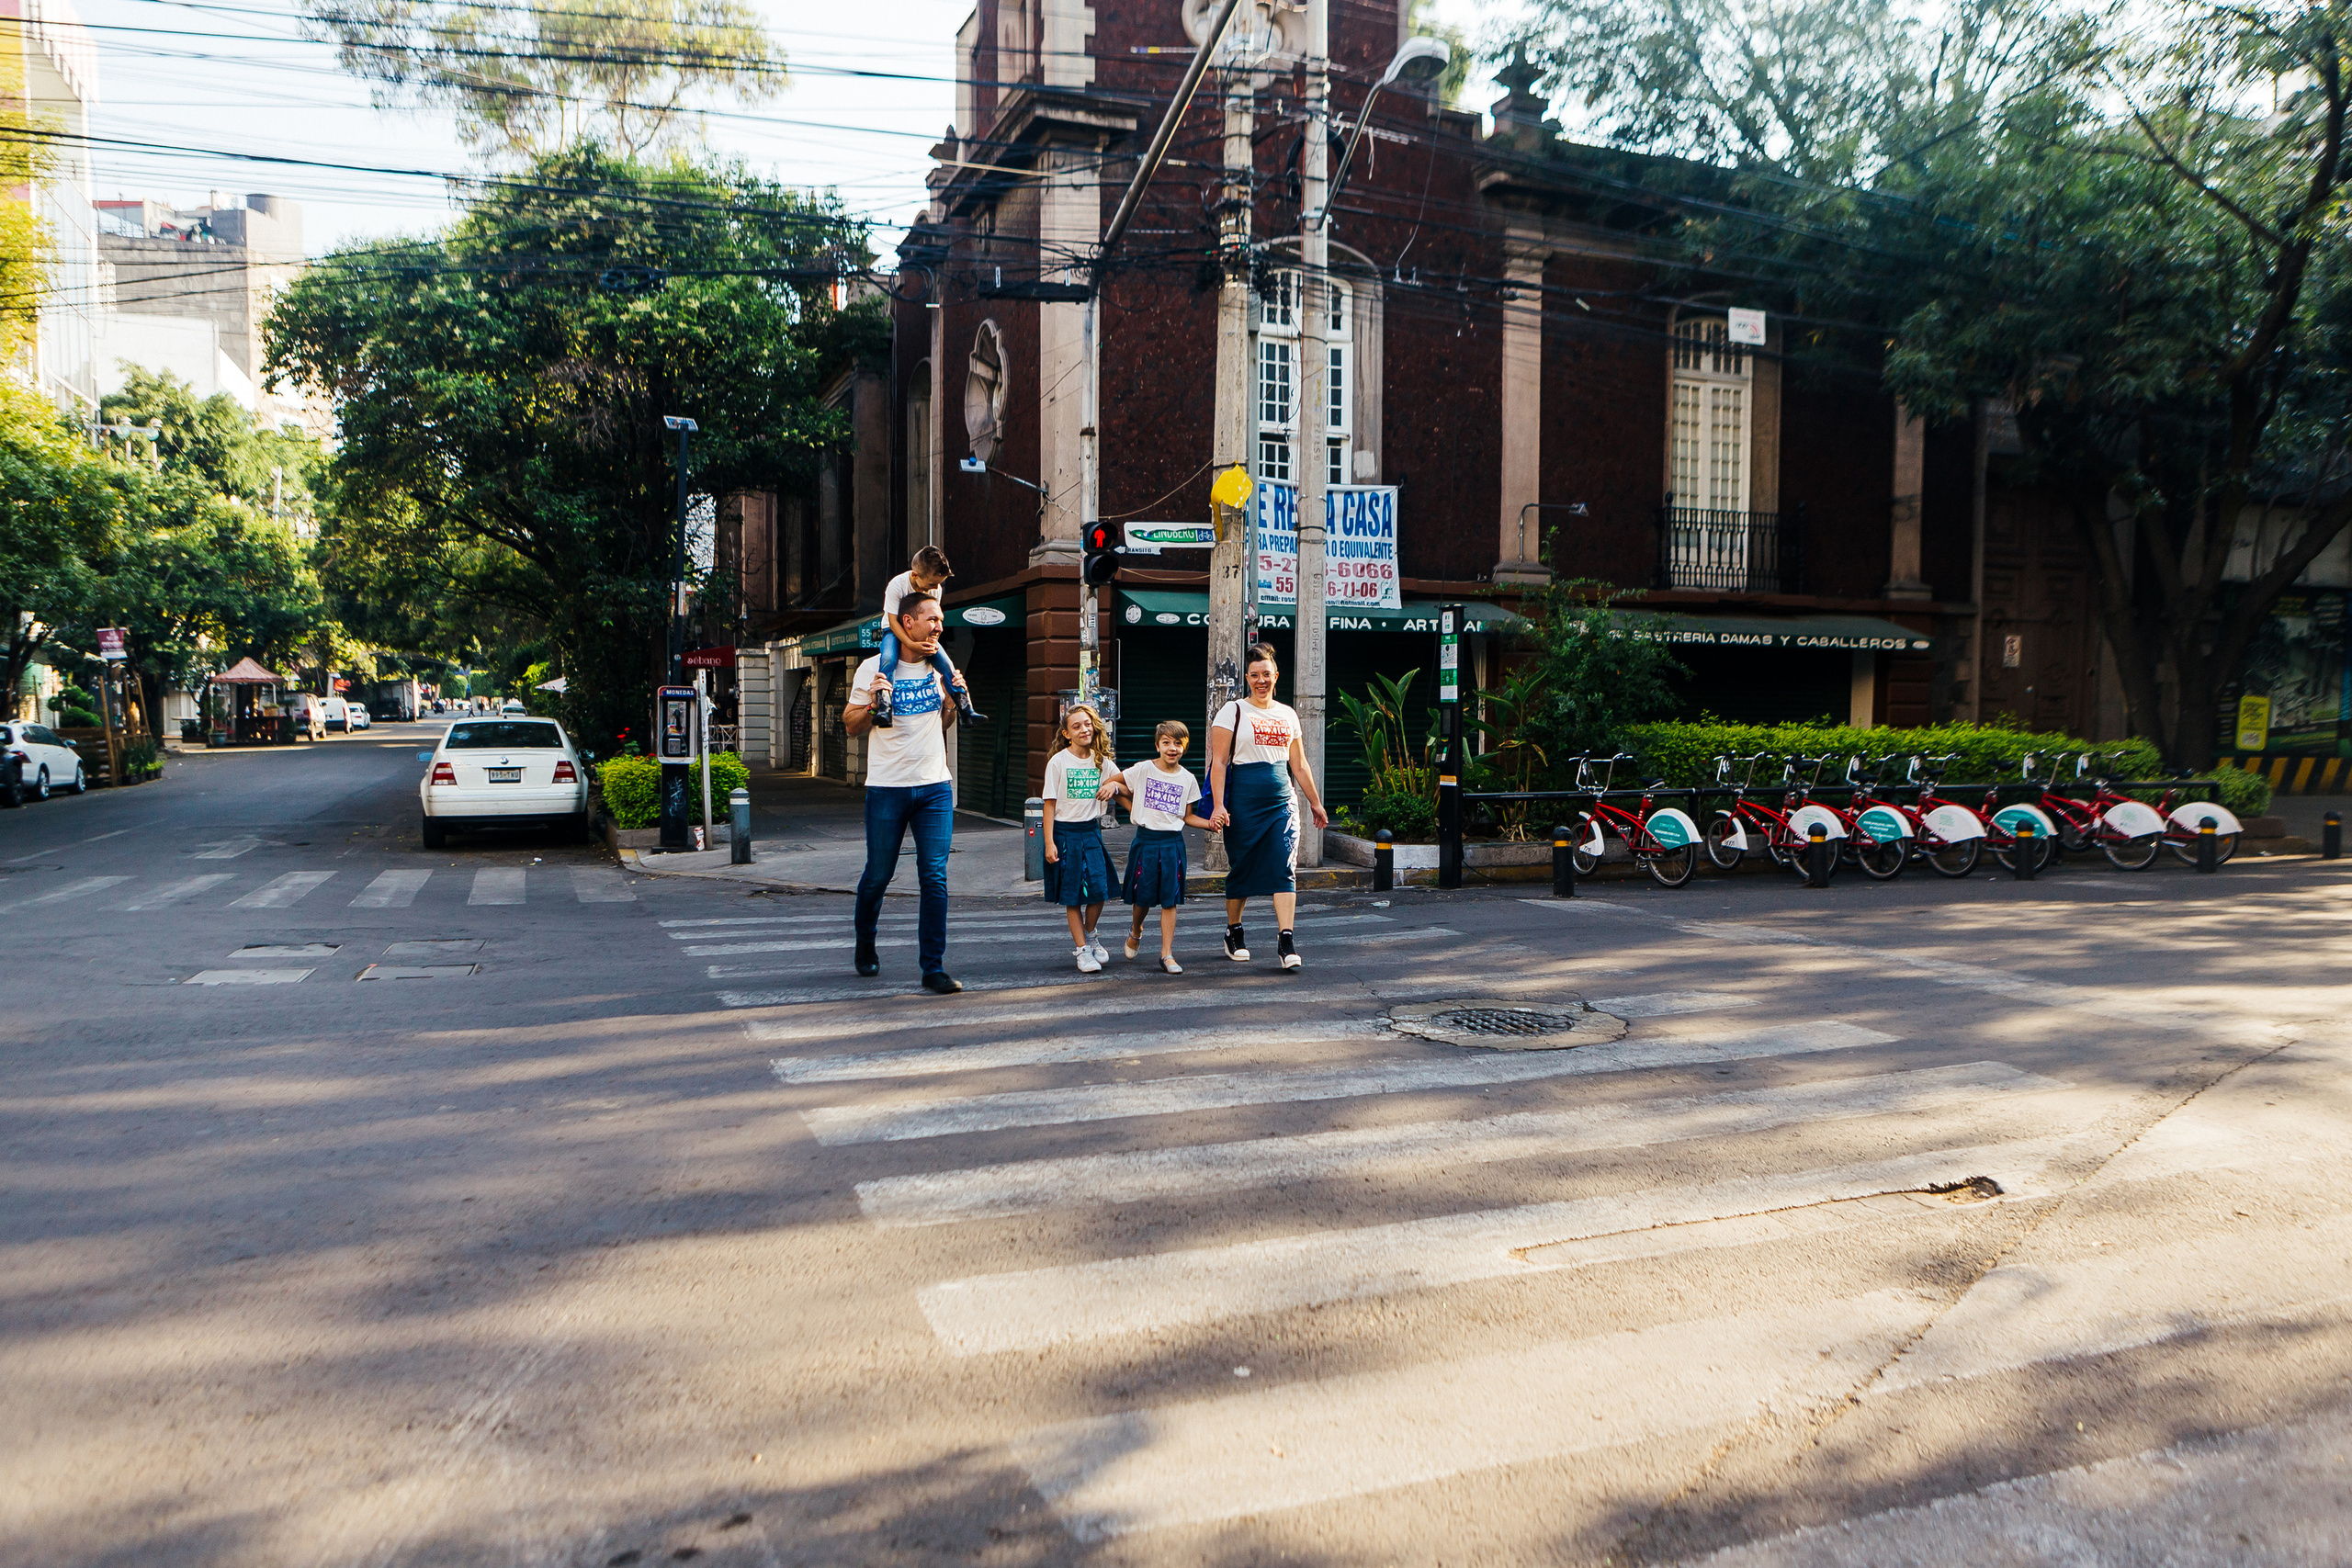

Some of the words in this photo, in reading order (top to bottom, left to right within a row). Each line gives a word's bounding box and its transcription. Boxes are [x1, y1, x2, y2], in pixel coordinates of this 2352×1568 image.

[1342, 491, 1393, 537] CASA
[1331, 540, 1338, 558] O
[1340, 539, 1393, 560] EQUIVALENTE
[1261, 594, 1281, 603] email:
[1187, 613, 1290, 627] CURA
[1329, 617, 1372, 630] FINA
[1721, 633, 1772, 645] DAMAS
[1781, 635, 1791, 646] Y
[1796, 636, 1906, 650] CABALLEROS
[1068, 777, 1101, 789] MEXIC
[1146, 787, 1182, 806] MEXICO
